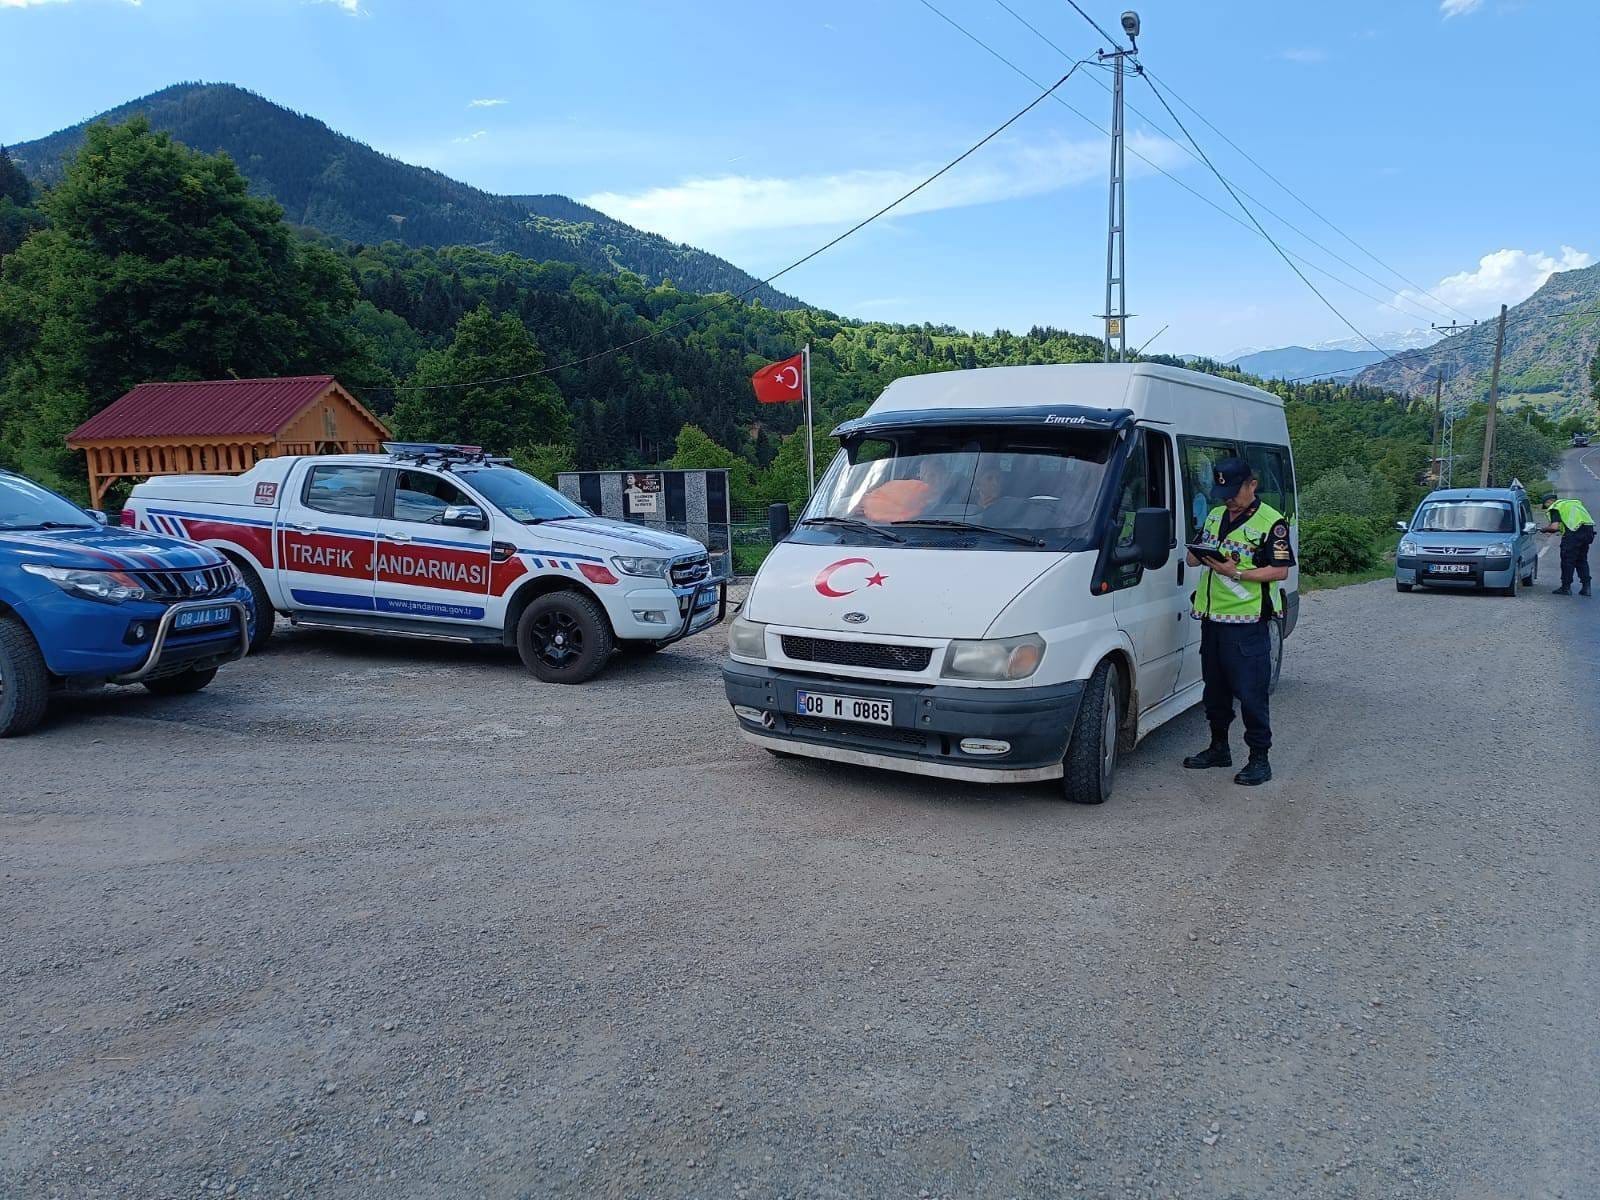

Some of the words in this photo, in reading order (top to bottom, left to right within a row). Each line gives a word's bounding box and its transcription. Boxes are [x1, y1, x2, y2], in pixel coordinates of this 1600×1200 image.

[258, 485, 274, 496] 112
[365, 553, 487, 585] JANDARMASI
[181, 613, 193, 625] 08
[193, 610, 210, 624] JAA
[215, 608, 229, 620] 131
[387, 600, 472, 616] www.jandarma.gov.tr
[806, 696, 823, 713] 08
[834, 699, 843, 716] M
[853, 701, 889, 721] 0885
